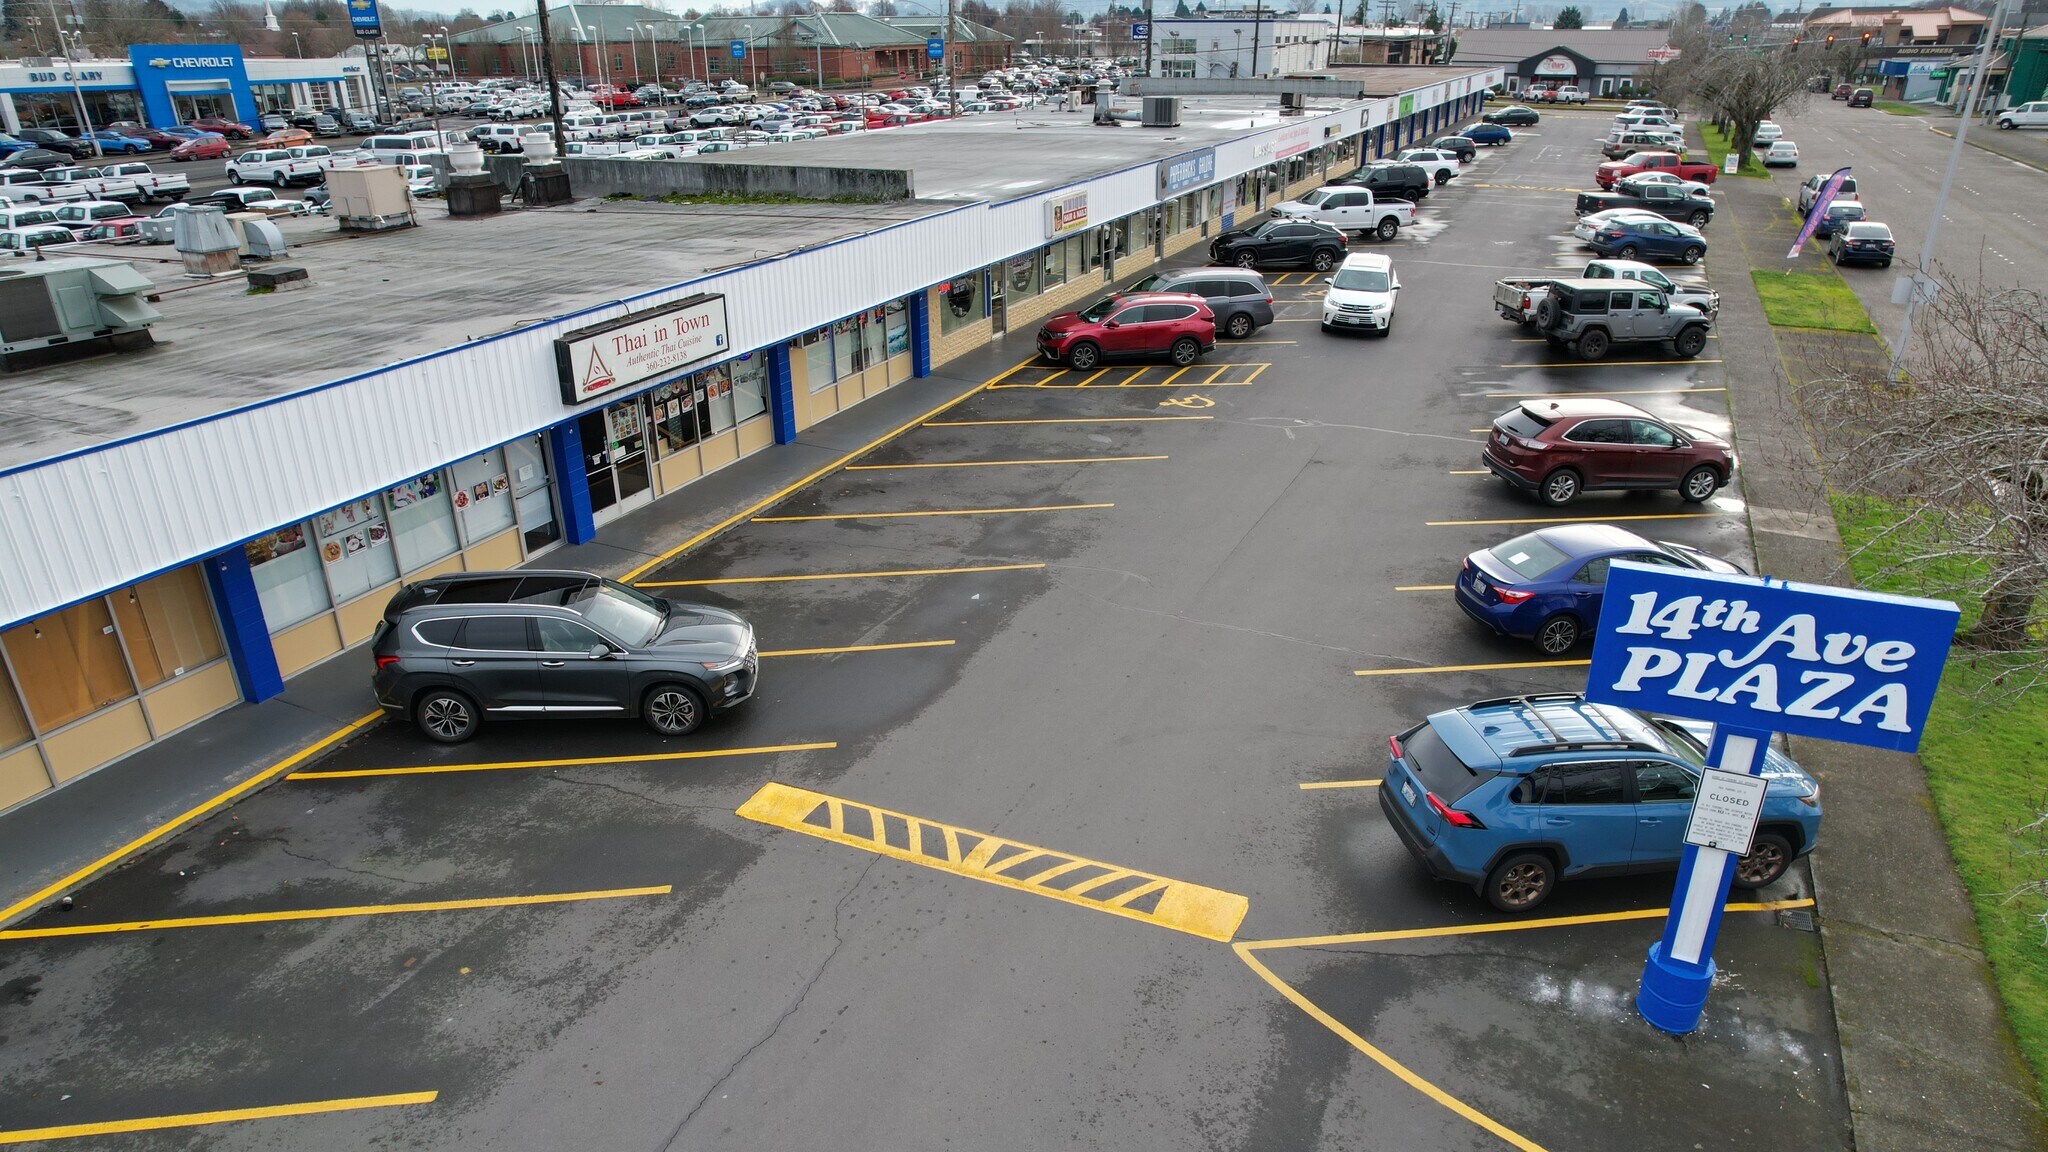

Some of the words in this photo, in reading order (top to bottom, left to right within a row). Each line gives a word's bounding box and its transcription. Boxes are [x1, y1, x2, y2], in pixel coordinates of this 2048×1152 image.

[173, 56, 234, 68] CHEVROLET
[1647, 50, 1666, 59] sharp
[30, 72, 56, 82] BUD
[64, 71, 103, 81] CLARY
[1170, 159, 1196, 184] PAPERBACKS
[1198, 153, 1213, 174] GALORE
[1064, 212, 1073, 222] HAIR
[1076, 208, 1087, 218] NAILS
[612, 328, 648, 356] Thai
[654, 324, 668, 343] in
[673, 314, 710, 337] Town
[626, 347, 660, 368] Authentic
[661, 340, 676, 354] Thai
[677, 334, 702, 350] Cuisine
[646, 351, 688, 373] 360-232-8138
[1616, 591, 1761, 640] 14th
[1718, 614, 1916, 673] Ave
[1612, 647, 1911, 733] PLAZA
[1709, 793, 1749, 807] CLOSED
